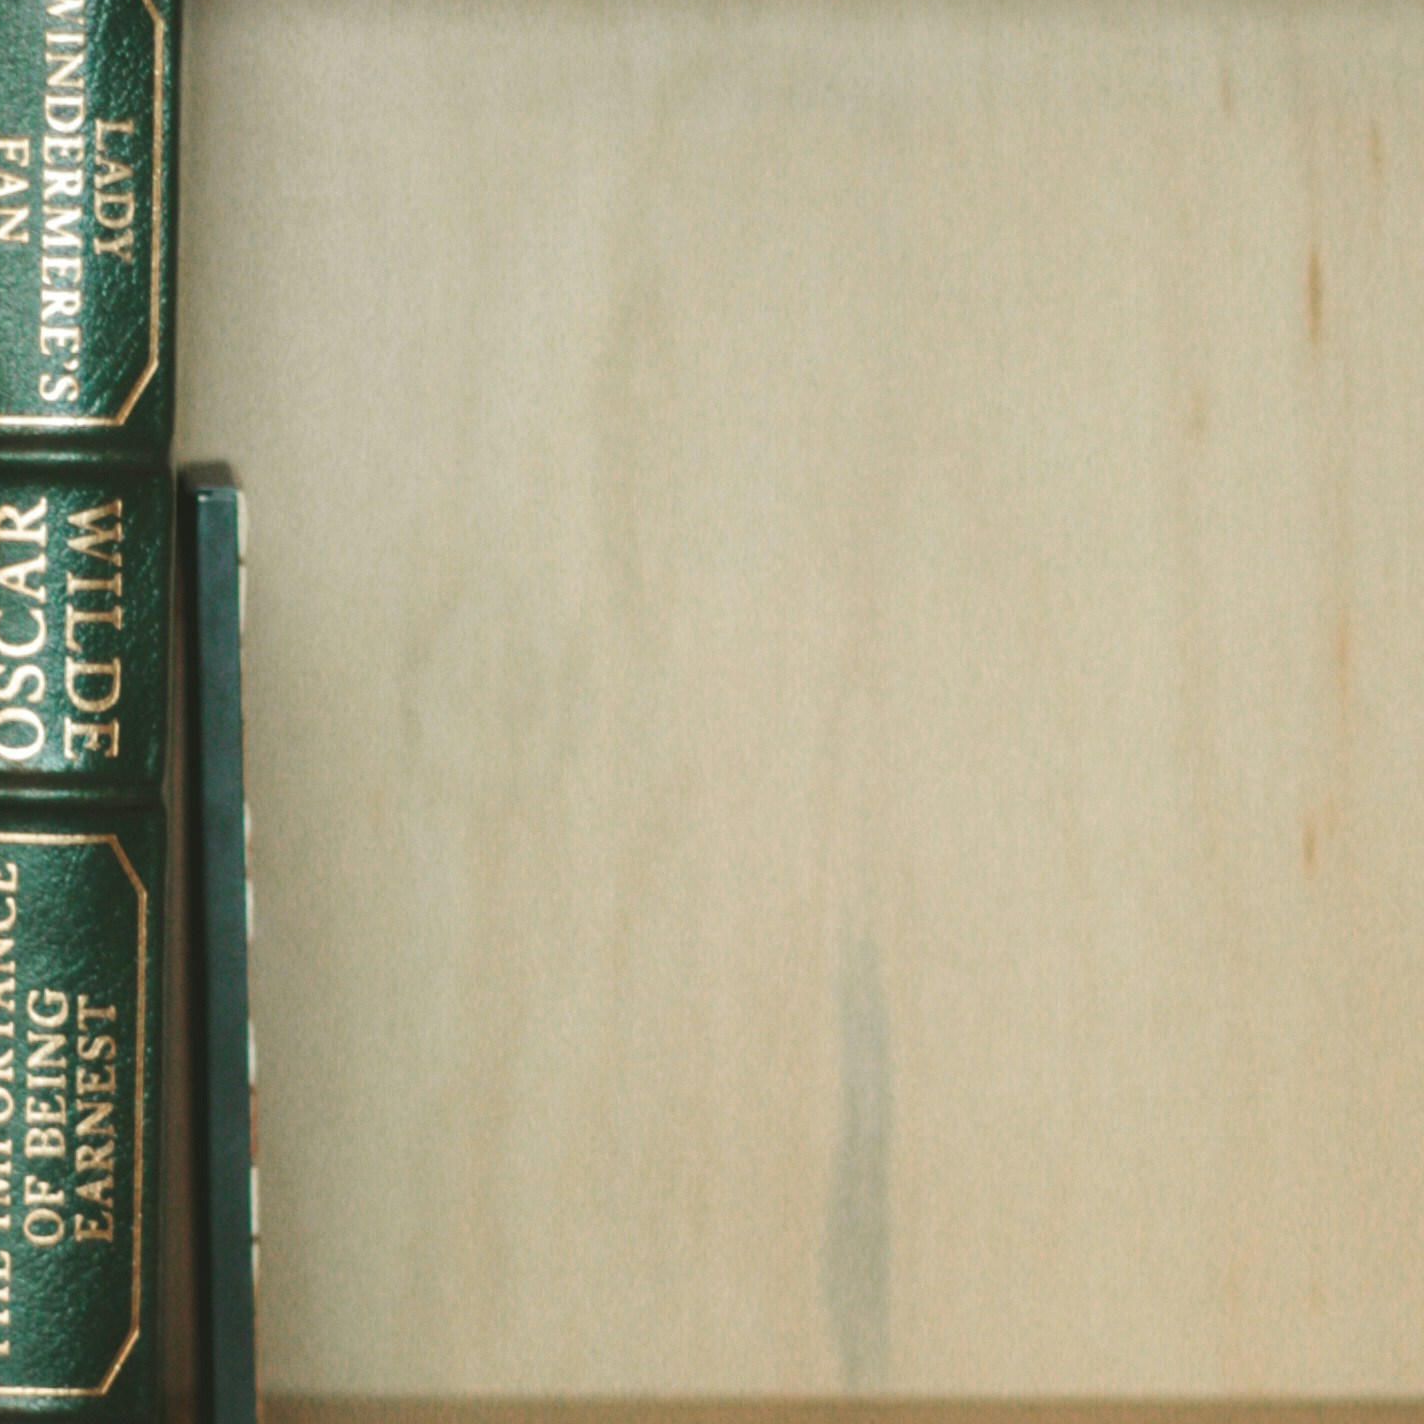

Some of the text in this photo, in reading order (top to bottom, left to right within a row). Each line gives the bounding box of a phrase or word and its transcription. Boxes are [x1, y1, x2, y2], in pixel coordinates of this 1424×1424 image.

[94, 118, 134, 265] LADY
[65, 499, 123, 760] WILDE
[23, 988, 70, 1248] OF BEING
[74, 995, 117, 1244] EARNEST
